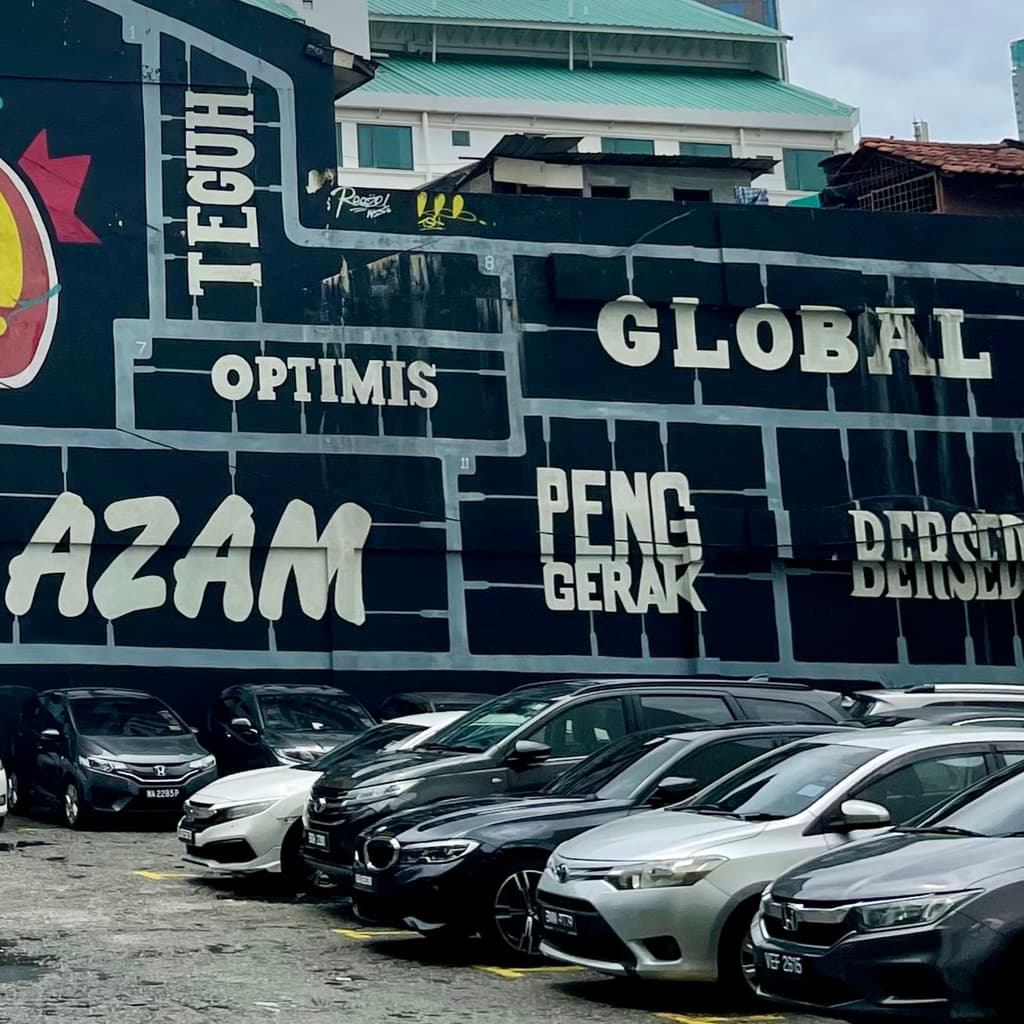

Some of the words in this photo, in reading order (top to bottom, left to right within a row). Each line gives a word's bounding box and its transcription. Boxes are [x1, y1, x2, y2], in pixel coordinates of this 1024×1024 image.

[184, 91, 263, 296] TEGUH
[484, 255, 495, 270] 8
[135, 341, 147, 355] 7
[596, 294, 993, 380] GLOBAL
[211, 354, 439, 409] OPTIMIS
[536, 466, 702, 562] PENG
[5, 491, 373, 626] AZAM
[540, 559, 707, 614] GERAK
